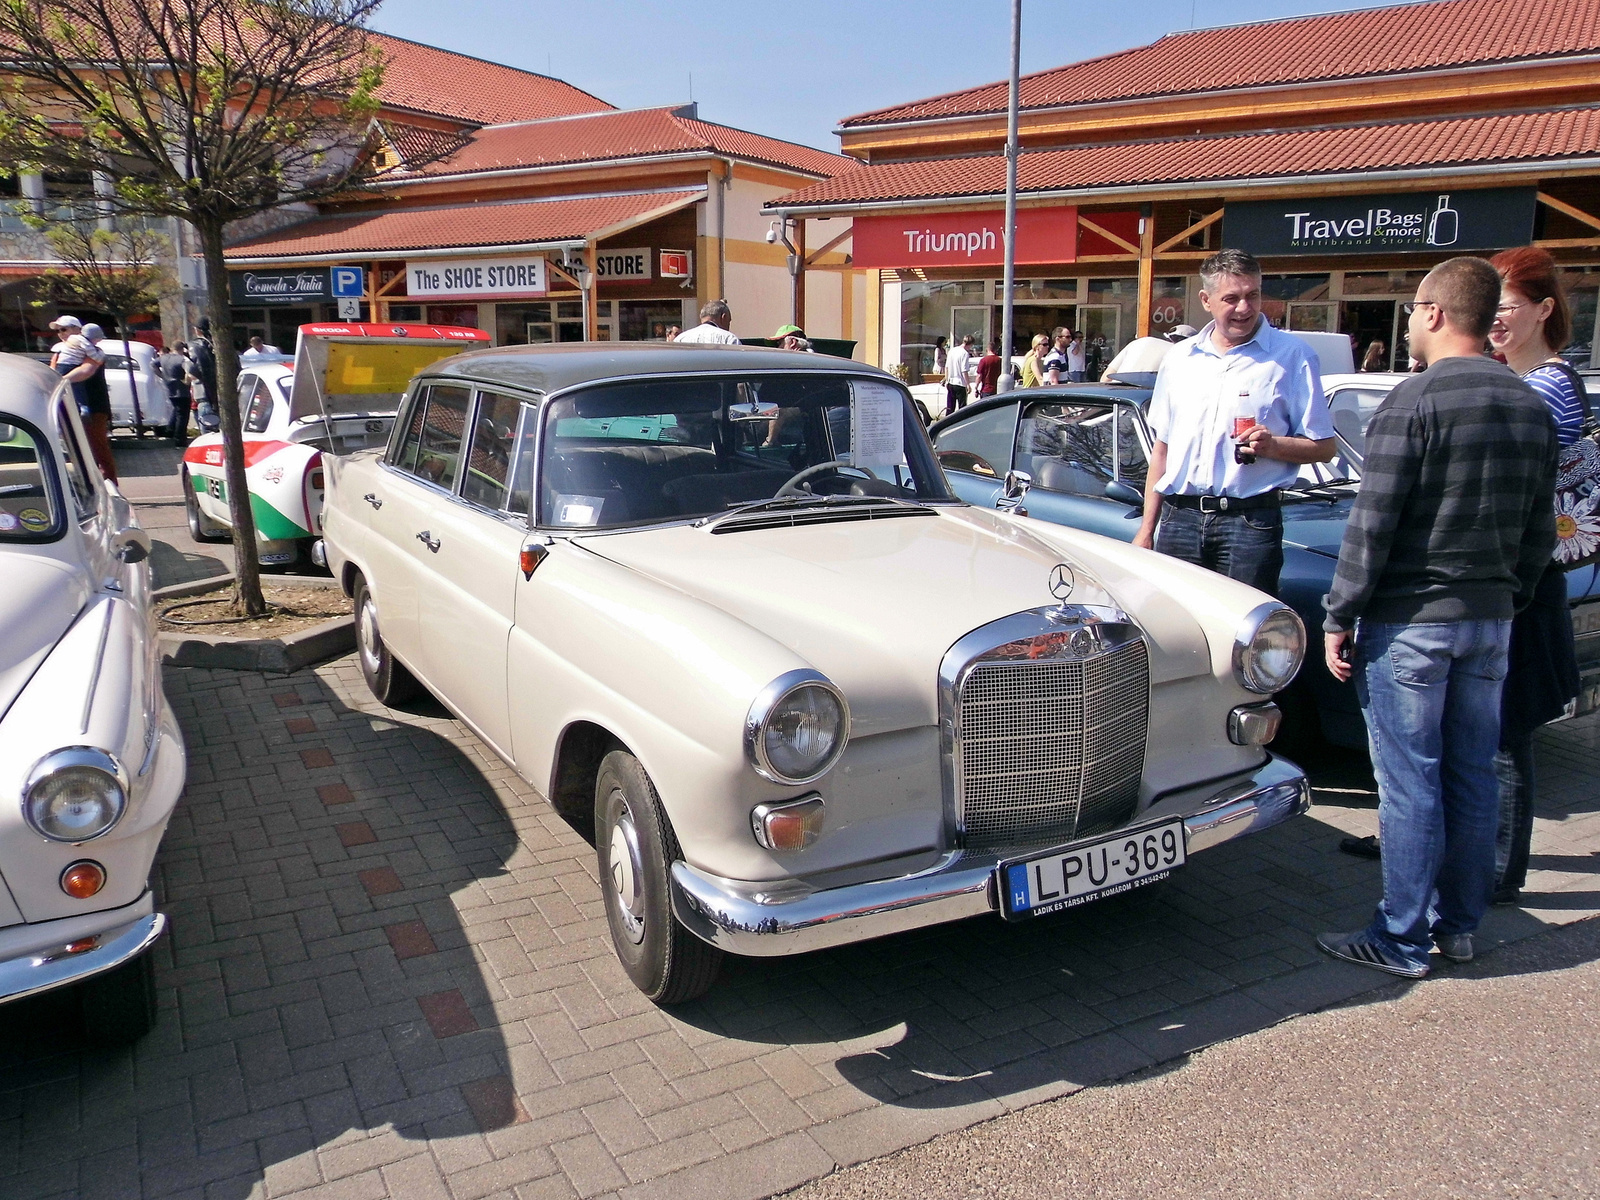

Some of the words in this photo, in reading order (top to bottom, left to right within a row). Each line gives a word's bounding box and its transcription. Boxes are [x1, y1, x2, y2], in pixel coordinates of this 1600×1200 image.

[1284, 209, 1374, 240] Travel
[1375, 208, 1423, 228] Bags
[903, 227, 996, 257] Triumph
[1290, 238, 1372, 247] Multibrand
[1381, 237, 1420, 245] Store
[1373, 226, 1422, 237] &more
[597, 255, 644, 276] STORE
[243, 272, 287, 294] Comoda
[337, 271, 357, 293] P
[414, 270, 440, 290] The
[444, 267, 483, 289] SHOE
[488, 264, 537, 288] STORE
[1035, 829, 1177, 902] LPU-369
[1015, 892, 1025, 906] H
[1033, 904, 1055, 917] LADIK
[1054, 901, 1064, 911] ÉS
[1064, 896, 1085, 909] TÁRSA
[1085, 892, 1099, 902] KFT.
[1101, 882, 1132, 898] KOMÁROM
